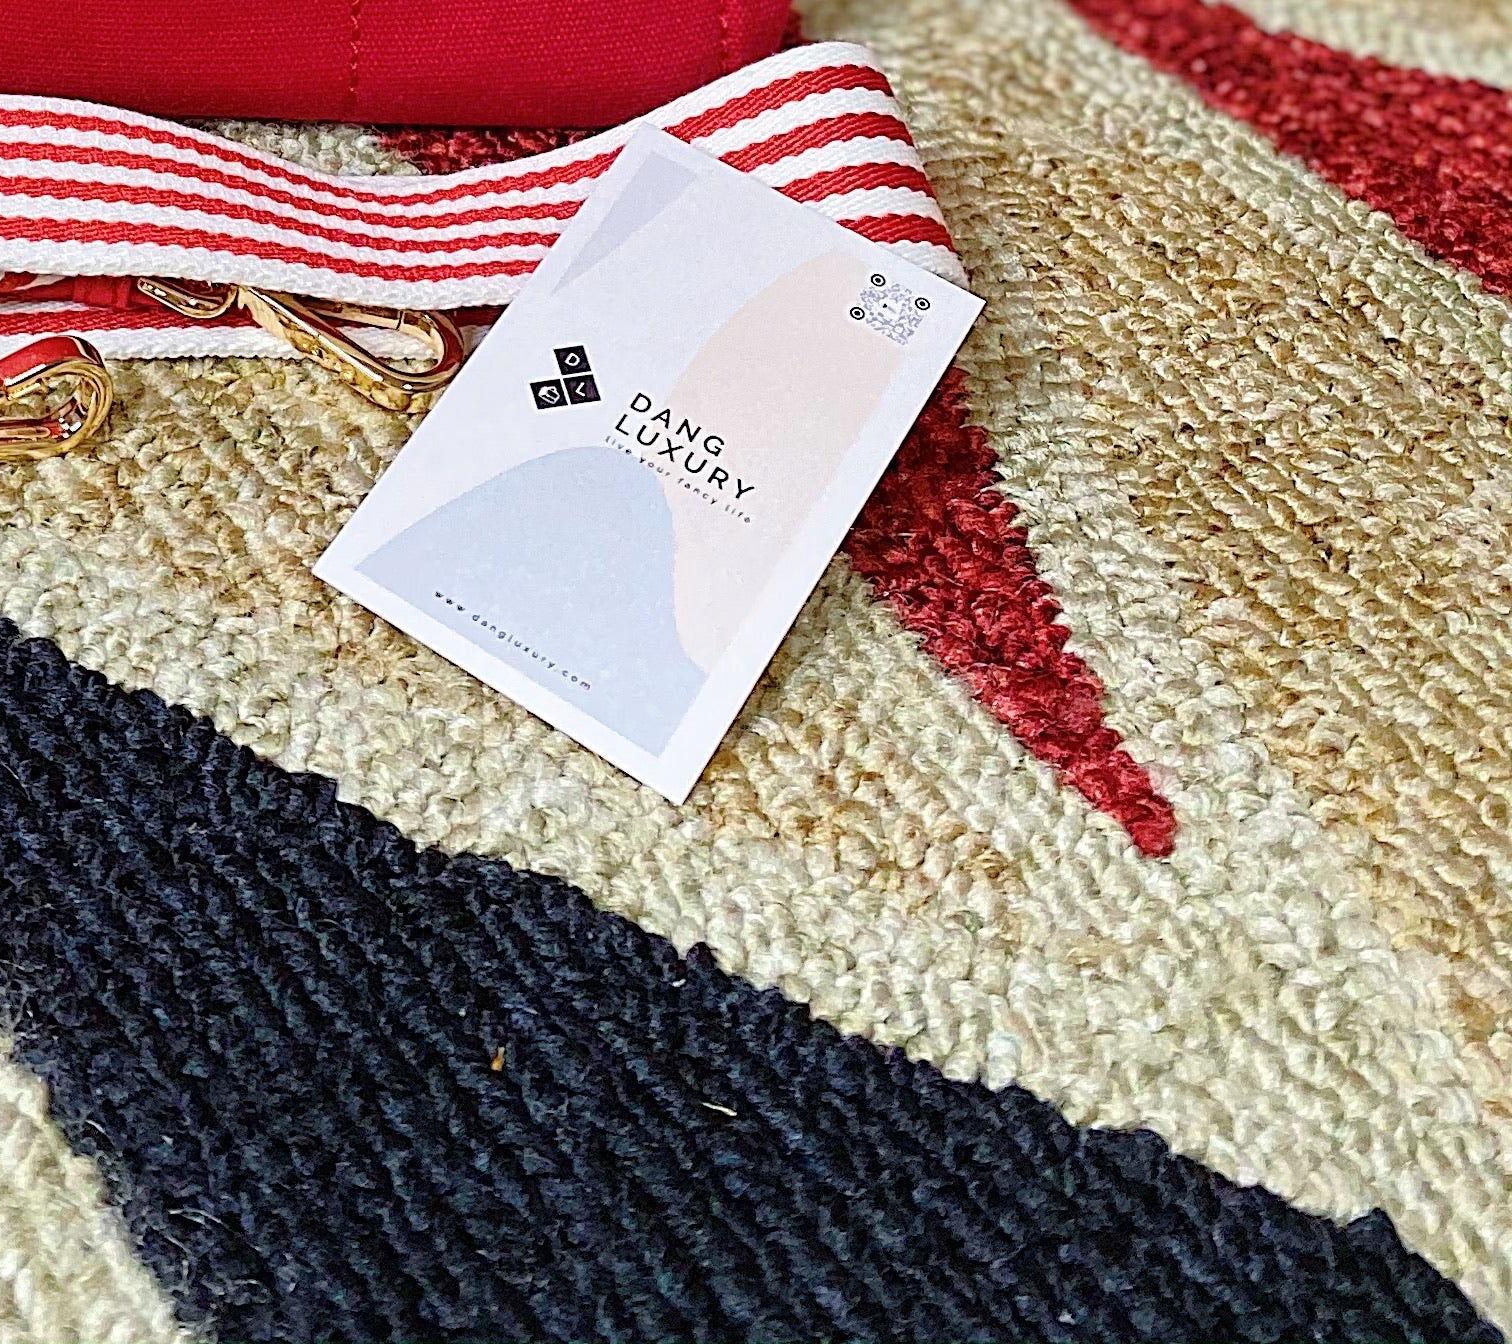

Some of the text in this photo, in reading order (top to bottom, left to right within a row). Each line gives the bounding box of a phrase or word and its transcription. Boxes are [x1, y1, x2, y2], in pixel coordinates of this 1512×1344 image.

[615, 413, 755, 499] LUXURY
[629, 392, 725, 457] DANG
[639, 456, 671, 477] your
[677, 477, 718, 505] fancy
